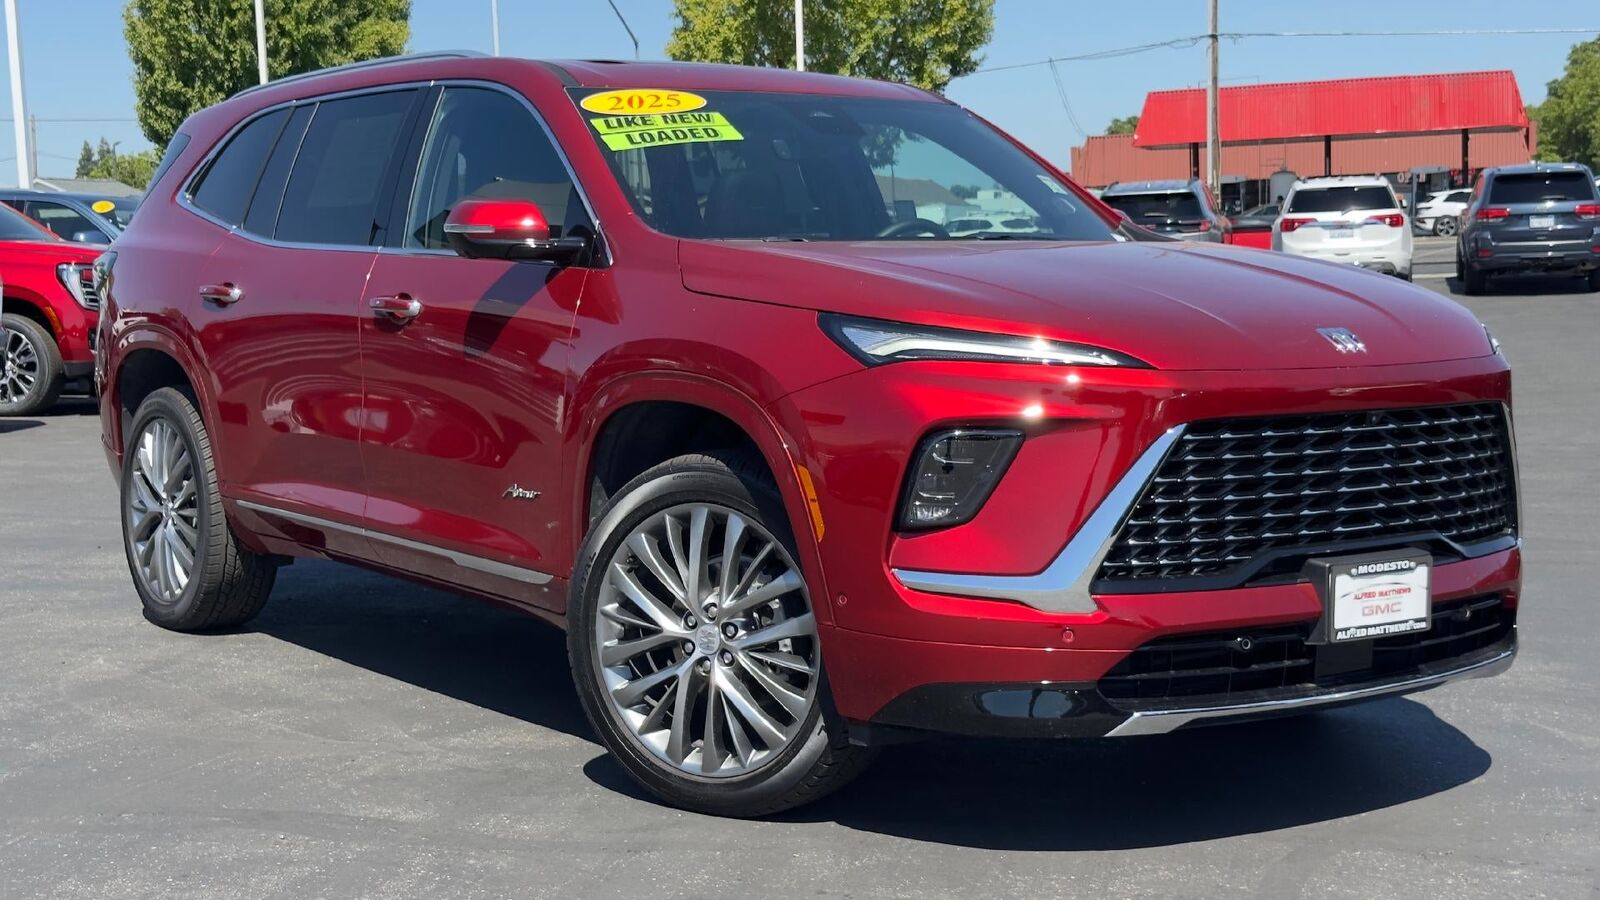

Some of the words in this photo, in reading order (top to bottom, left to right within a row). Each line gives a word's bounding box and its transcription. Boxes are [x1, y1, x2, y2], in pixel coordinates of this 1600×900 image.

[608, 94, 681, 111] 2025
[603, 113, 655, 130] LIKE
[662, 112, 713, 125] NEW
[625, 127, 719, 145] LOADED
[1357, 560, 1410, 575] MODESTO
[1353, 591, 1377, 600] ALFRED
[1378, 587, 1411, 598] MATTHEWS
[1361, 602, 1402, 617] GMC
